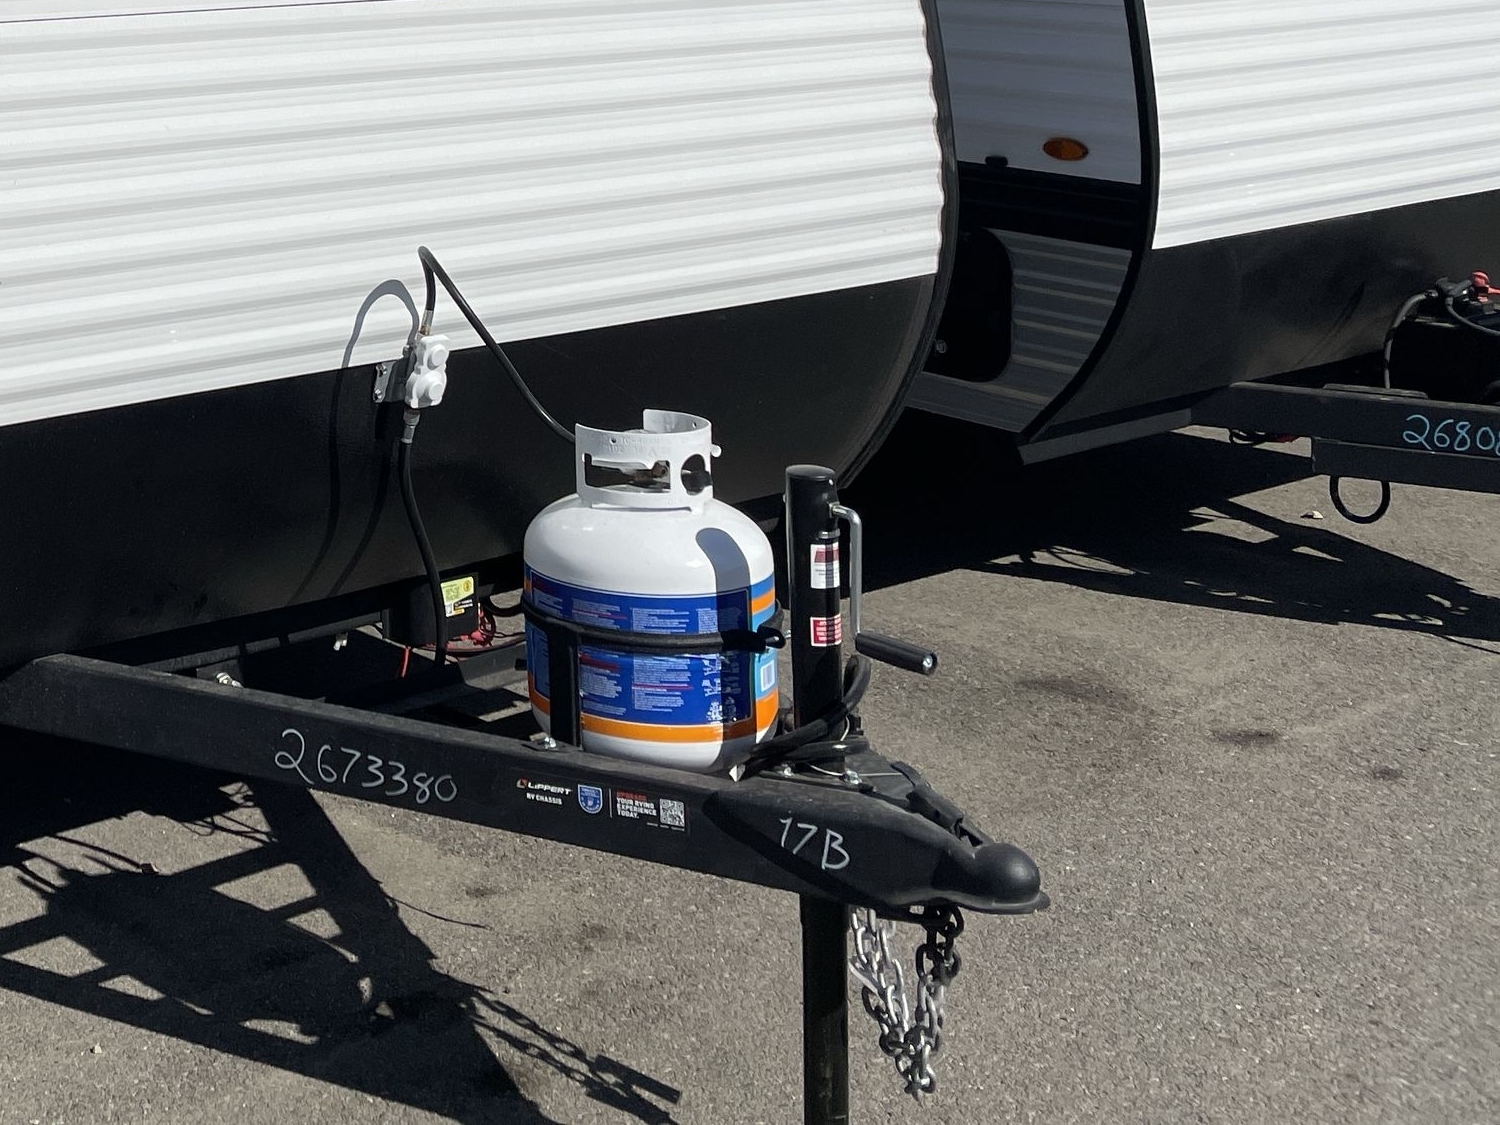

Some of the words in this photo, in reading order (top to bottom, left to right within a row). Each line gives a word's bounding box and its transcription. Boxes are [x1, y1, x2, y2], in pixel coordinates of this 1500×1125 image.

[274, 728, 458, 804] 2673380
[536, 794, 563, 805] CHASSIS
[779, 817, 850, 870] 17B
